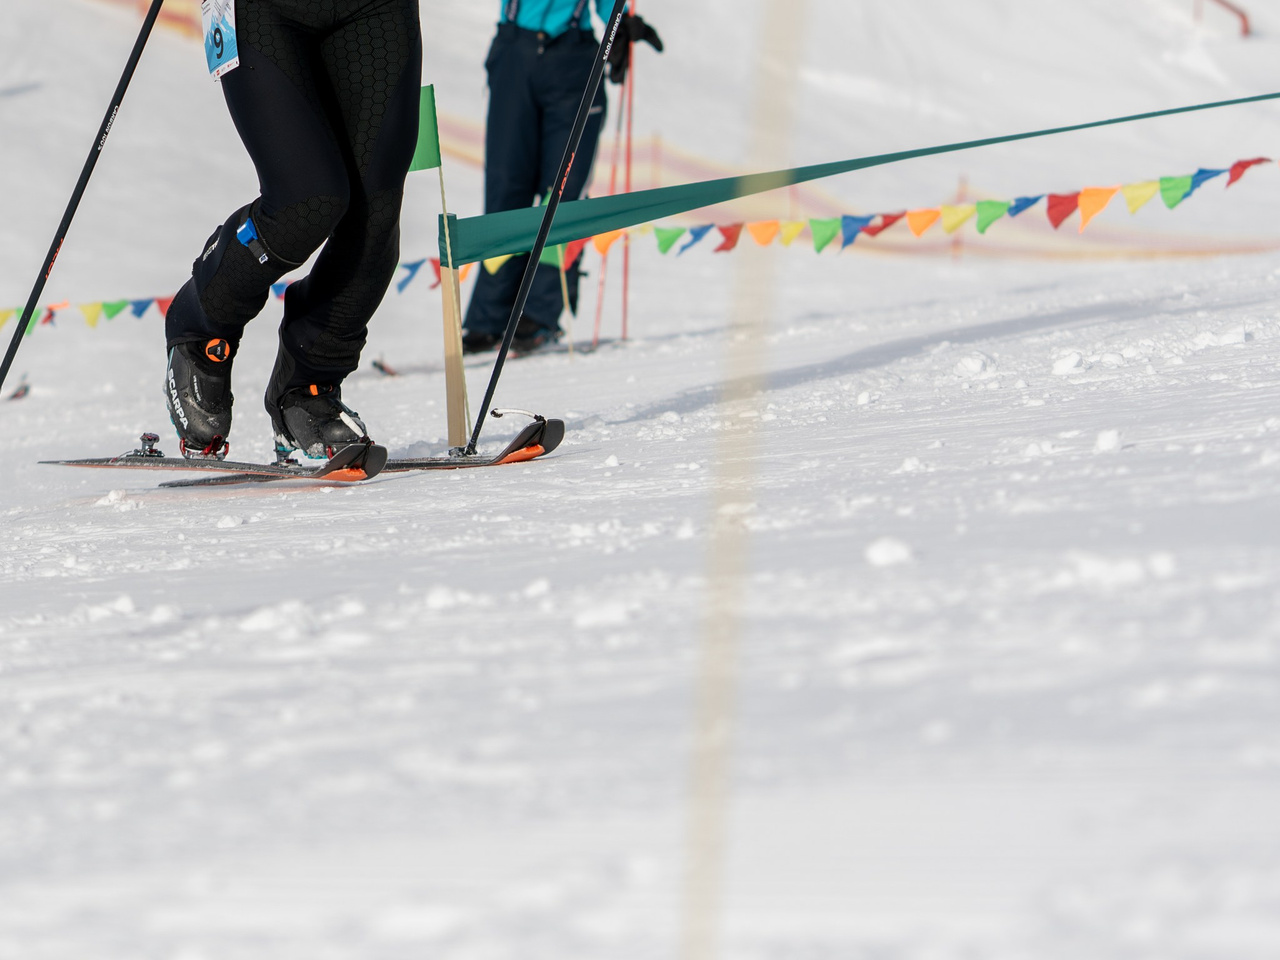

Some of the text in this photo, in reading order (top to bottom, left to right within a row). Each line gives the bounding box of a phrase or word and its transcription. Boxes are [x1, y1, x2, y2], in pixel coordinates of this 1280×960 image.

[609, 12, 621, 41] CARBON
[213, 27, 224, 59] 9
[167, 368, 189, 430] SCARPA
